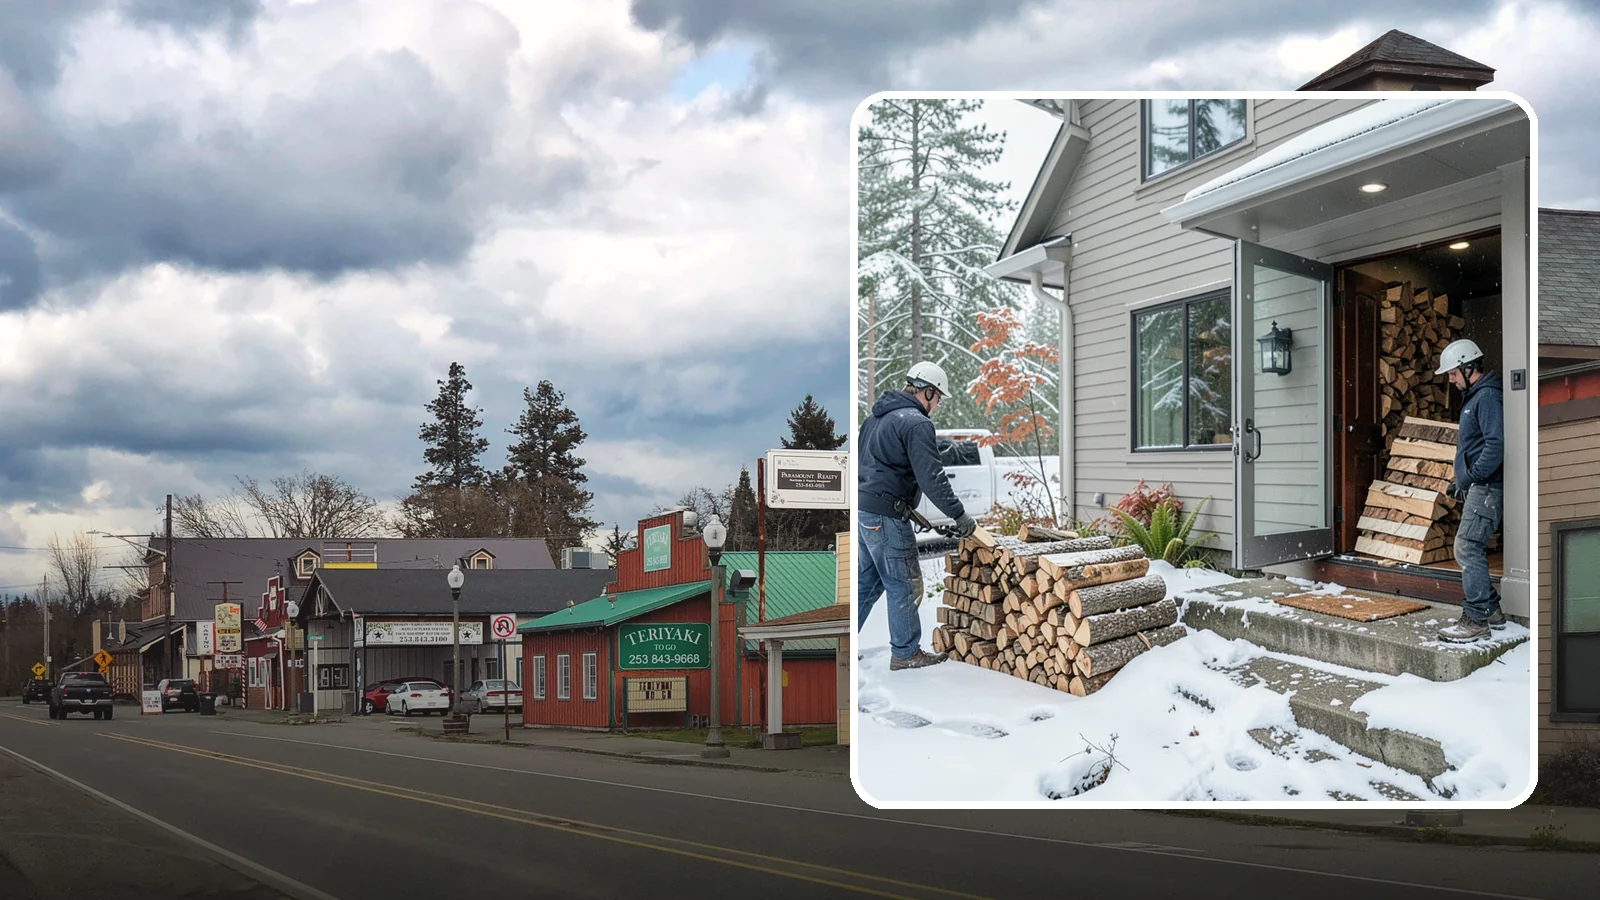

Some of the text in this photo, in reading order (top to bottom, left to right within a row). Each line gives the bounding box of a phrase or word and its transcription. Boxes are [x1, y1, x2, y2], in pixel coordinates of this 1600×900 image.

[625, 627, 702, 645] TERIYAKI
[629, 653, 700, 664] 253 843-9668
